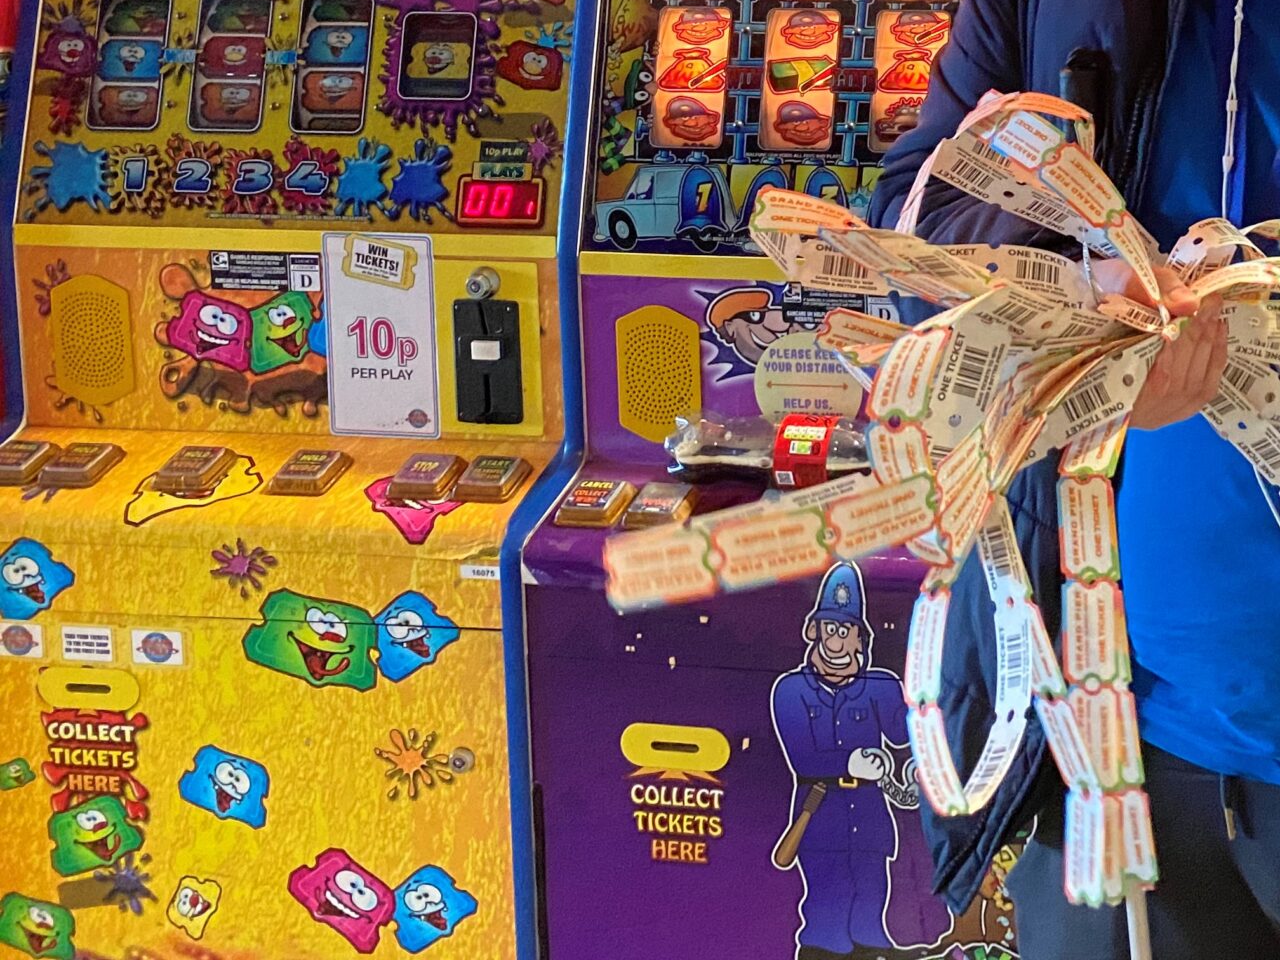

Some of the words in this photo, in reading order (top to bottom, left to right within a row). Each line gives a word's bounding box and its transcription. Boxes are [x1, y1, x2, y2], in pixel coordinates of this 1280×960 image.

[122, 157, 149, 192] 1
[174, 157, 212, 195] 2
[231, 159, 274, 196] 3
[284, 160, 329, 195] 4
[480, 163, 526, 180] PLAYS
[770, 214, 796, 223] ONE
[368, 243, 388, 257] WIN
[1008, 249, 1033, 259] ONE
[1035, 252, 1068, 267] TICKET
[355, 252, 399, 273] TICKETS!
[301, 274, 313, 288] D
[347, 316, 418, 367] 10p
[769, 348, 812, 361] PLEASE
[815, 349, 838, 361] KEE
[945, 332, 966, 373] TICKET
[351, 368, 377, 380] PER
[381, 368, 414, 381] PLAY
[764, 360, 793, 373] YOUR
[937, 374, 951, 401] ONE
[784, 398, 812, 410] HELP
[814, 399, 834, 411] US,
[1100, 401, 1125, 421] ONE
[1065, 413, 1102, 439] TICKET
[411, 460, 440, 473] STOP
[48, 722, 135, 742] COLLECT
[50, 747, 136, 768] TICKETS
[68, 774, 121, 792] HERE
[630, 784, 725, 810] COLLECT
[633, 811, 723, 837] TICKETS
[651, 839, 709, 864] HERE
